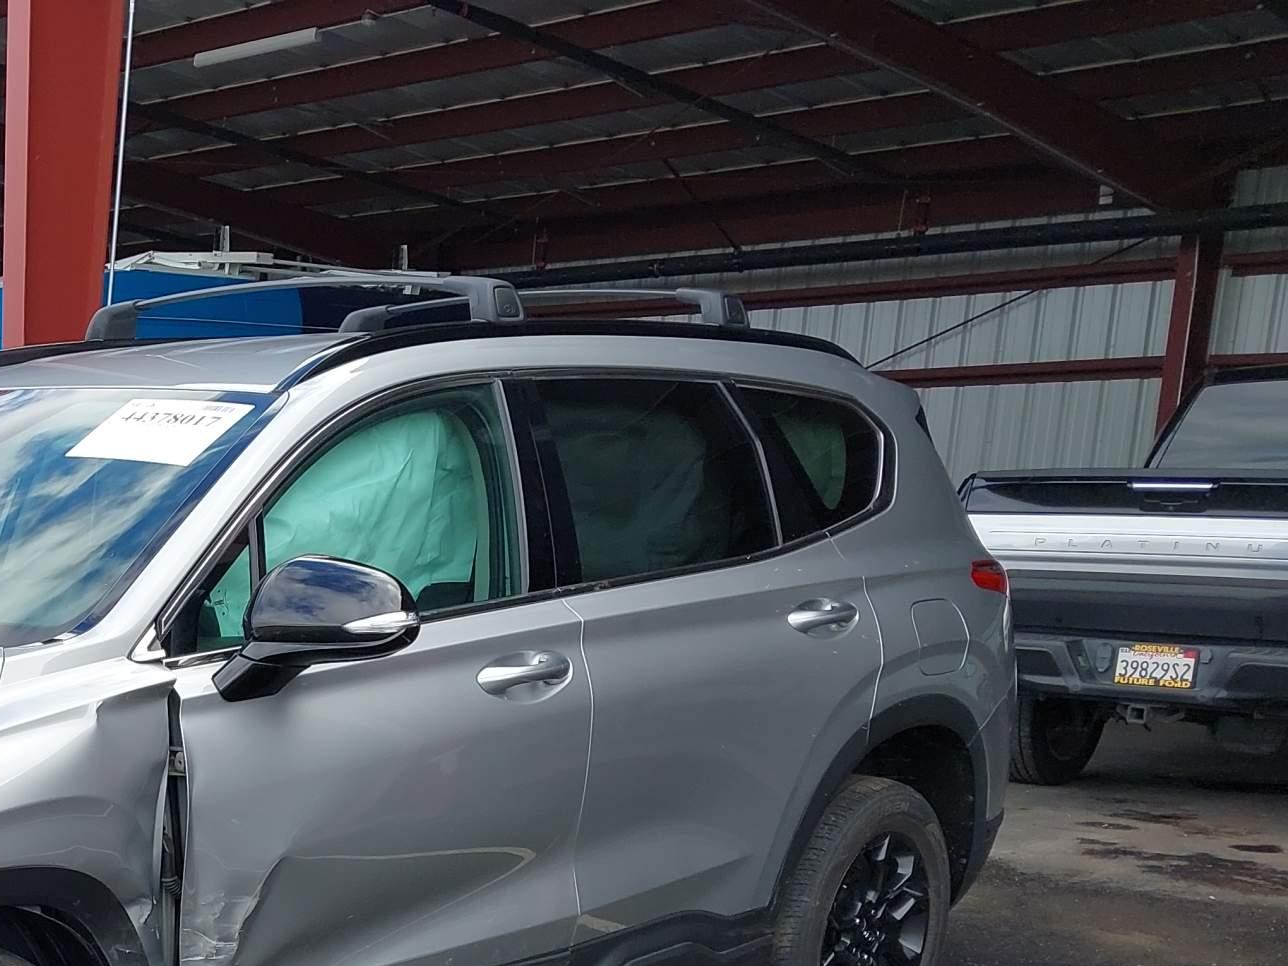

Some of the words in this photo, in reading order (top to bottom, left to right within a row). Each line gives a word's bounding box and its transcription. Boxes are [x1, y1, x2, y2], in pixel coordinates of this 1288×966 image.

[122, 411, 223, 427] 44378017
[1134, 644, 1179, 653] ROSEVILLE
[1118, 659, 1191, 681] 39829S2
[1114, 676, 1155, 686] FUTURE
[1159, 679, 1191, 688] FORD
